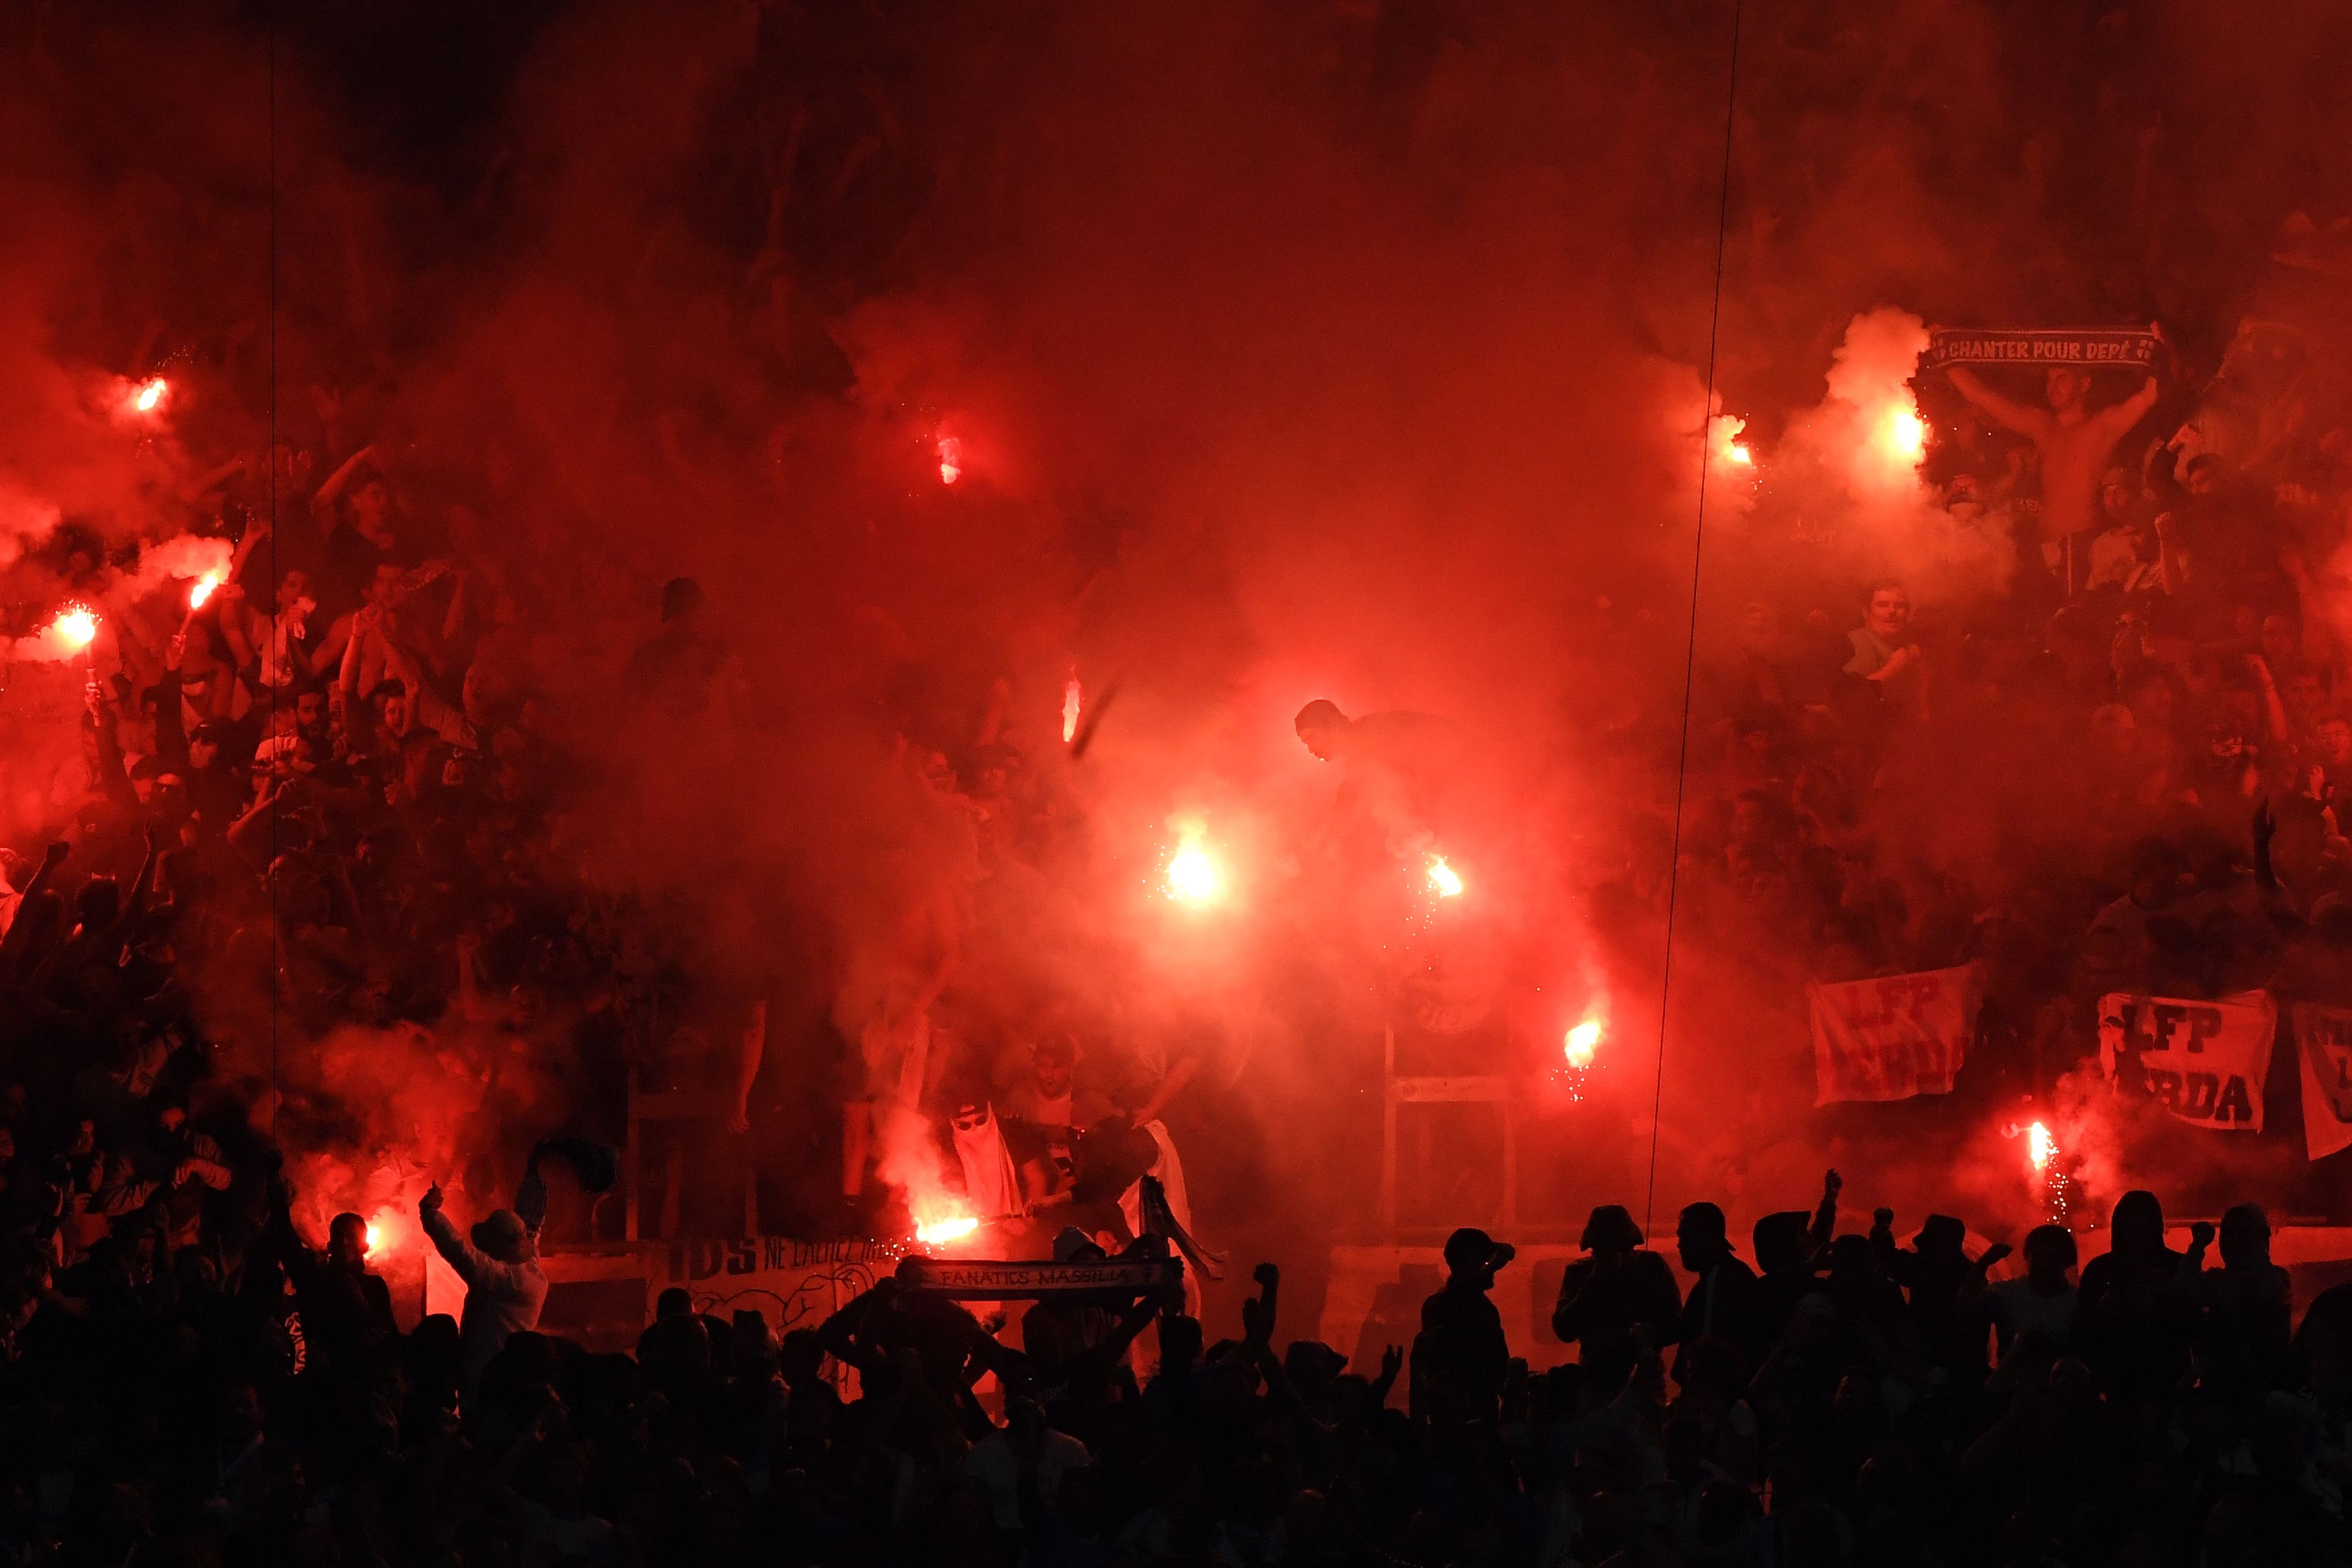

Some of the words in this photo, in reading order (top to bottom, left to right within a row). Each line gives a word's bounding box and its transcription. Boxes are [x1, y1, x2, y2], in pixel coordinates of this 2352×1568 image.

[1949, 340, 2028, 358] CHANTER
[2034, 342, 2081, 360] POUR
[2122, 1004, 2222, 1053] LFP
[2135, 1069, 2253, 1122] RDA
[764, 1236, 786, 1271] NE
[941, 1270, 1029, 1286] FANATICS
[1039, 1269, 1130, 1285] MASSILIA
